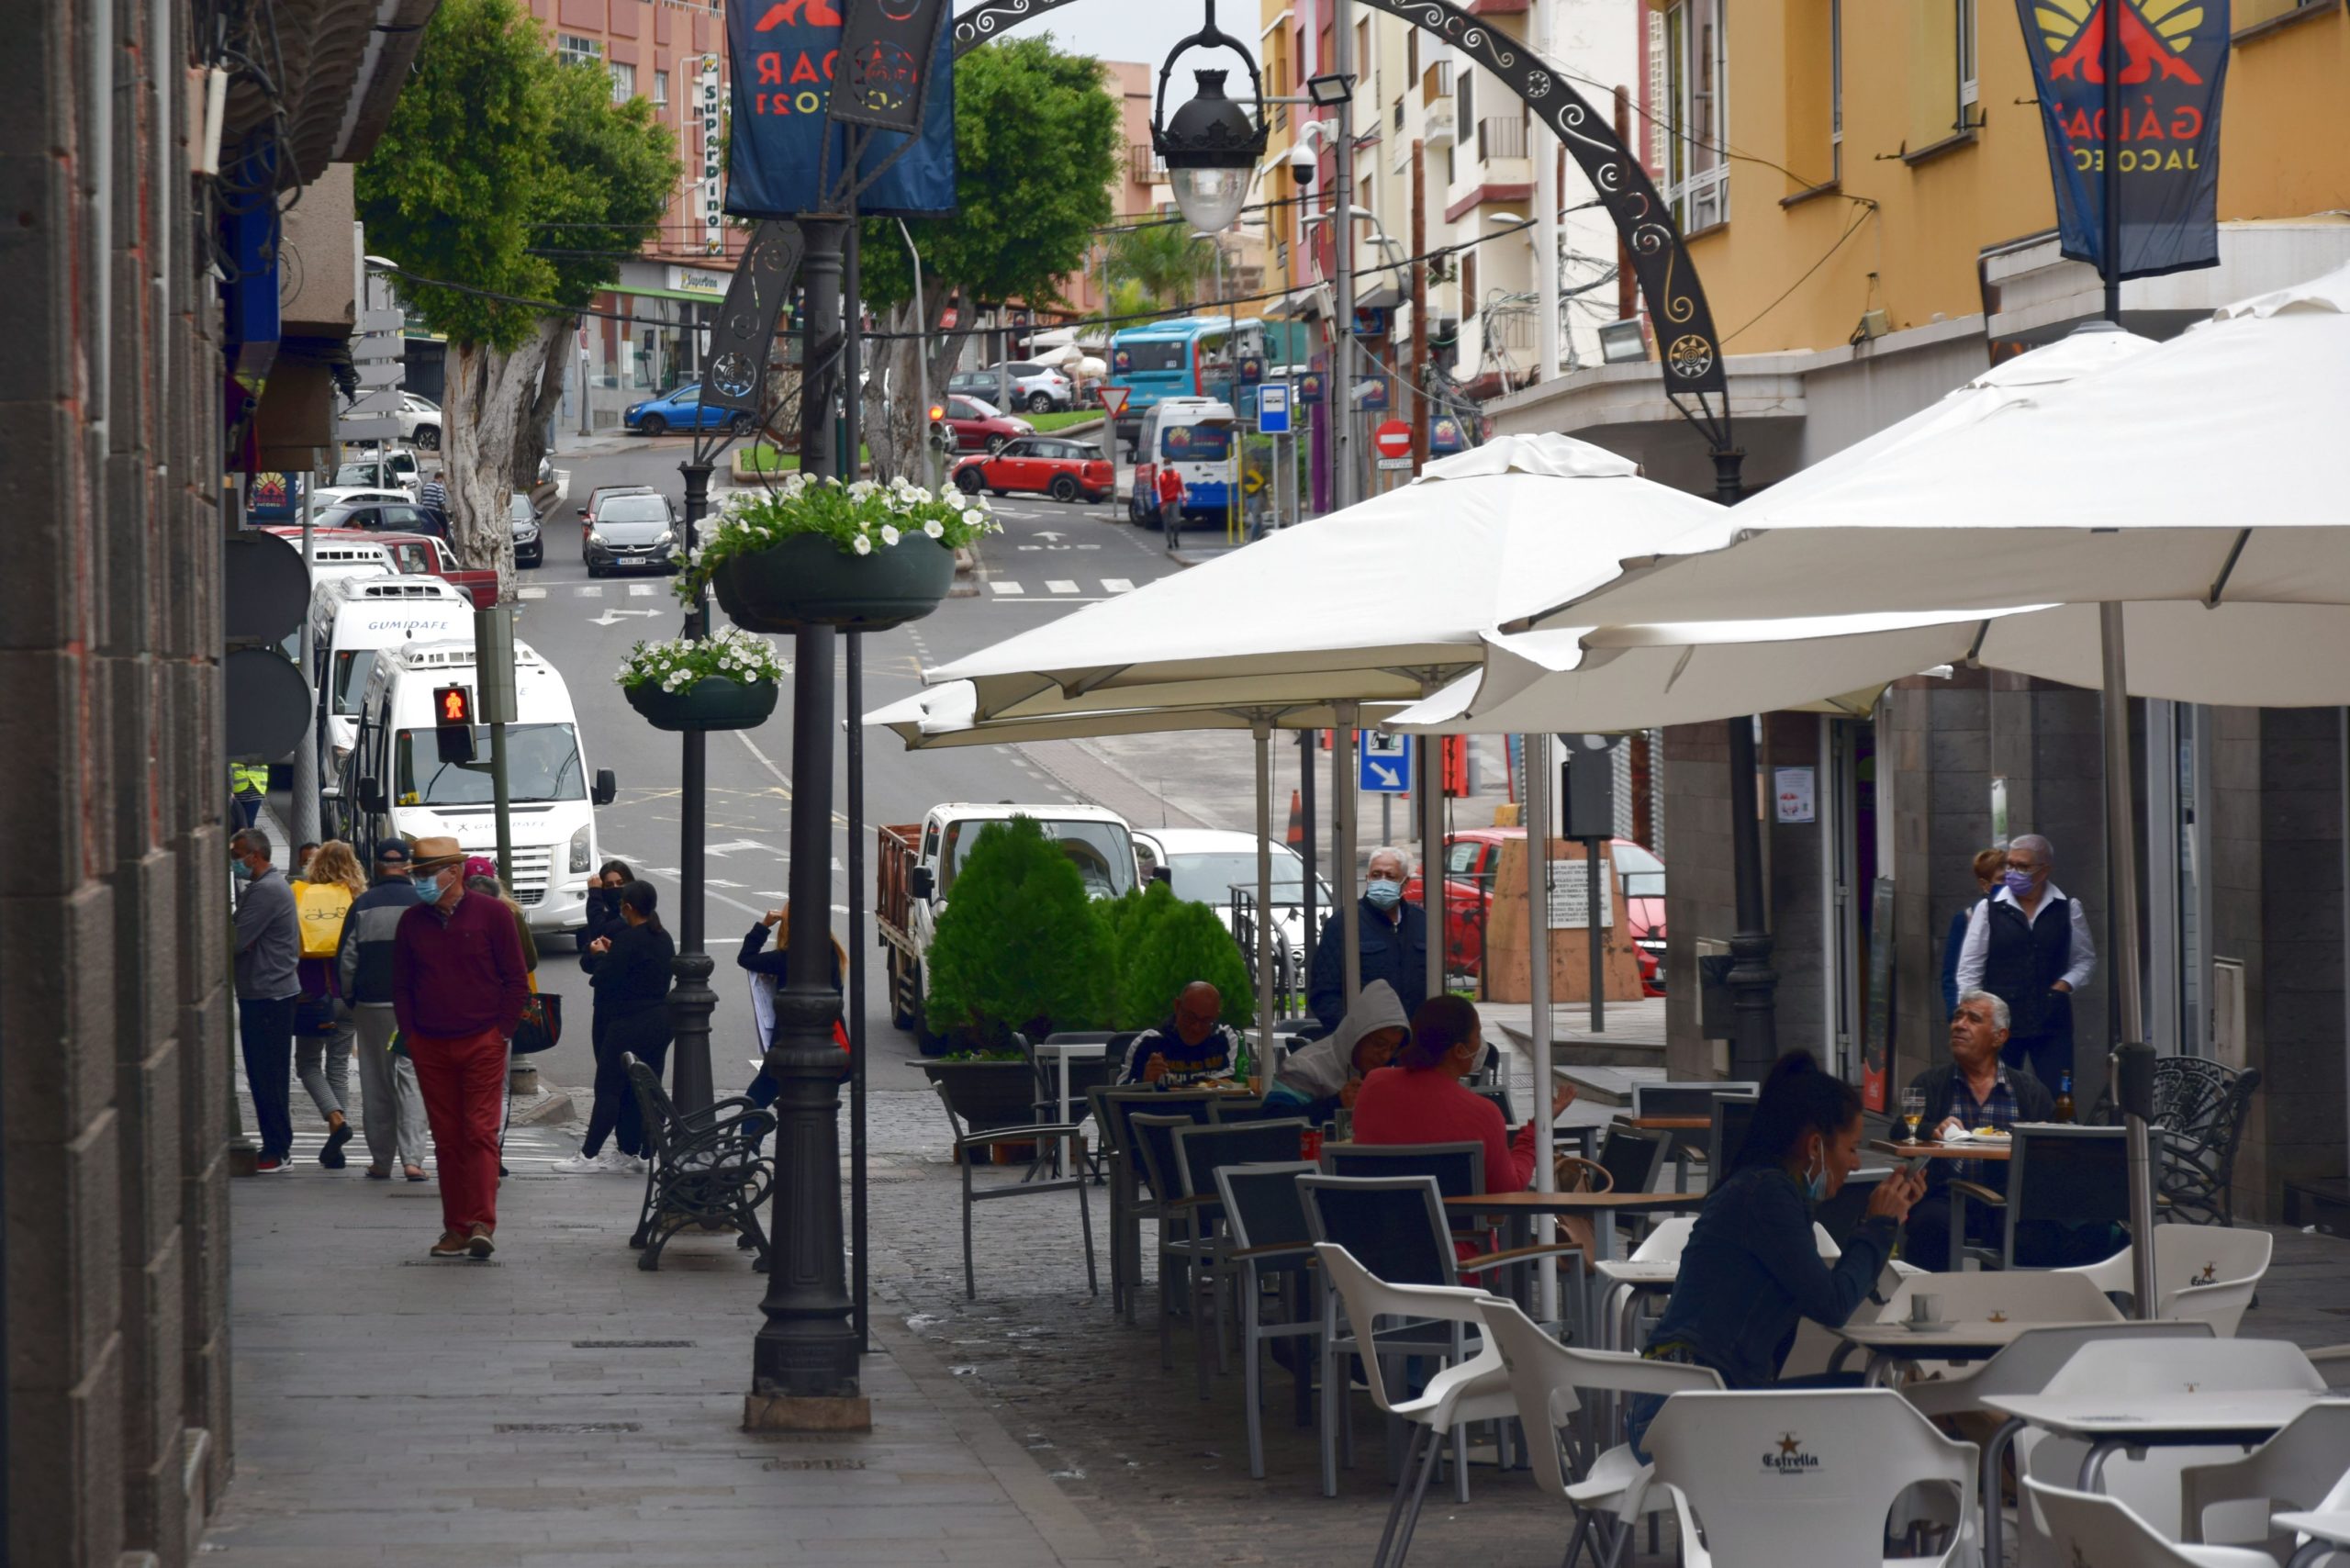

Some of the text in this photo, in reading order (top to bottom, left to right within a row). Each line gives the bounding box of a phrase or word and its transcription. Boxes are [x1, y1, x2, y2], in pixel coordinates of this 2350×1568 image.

[368, 621, 449, 631] GUMIDAFE
[474, 821, 547, 830] GUDAFE
[1762, 1452, 1818, 1468] Estrella
